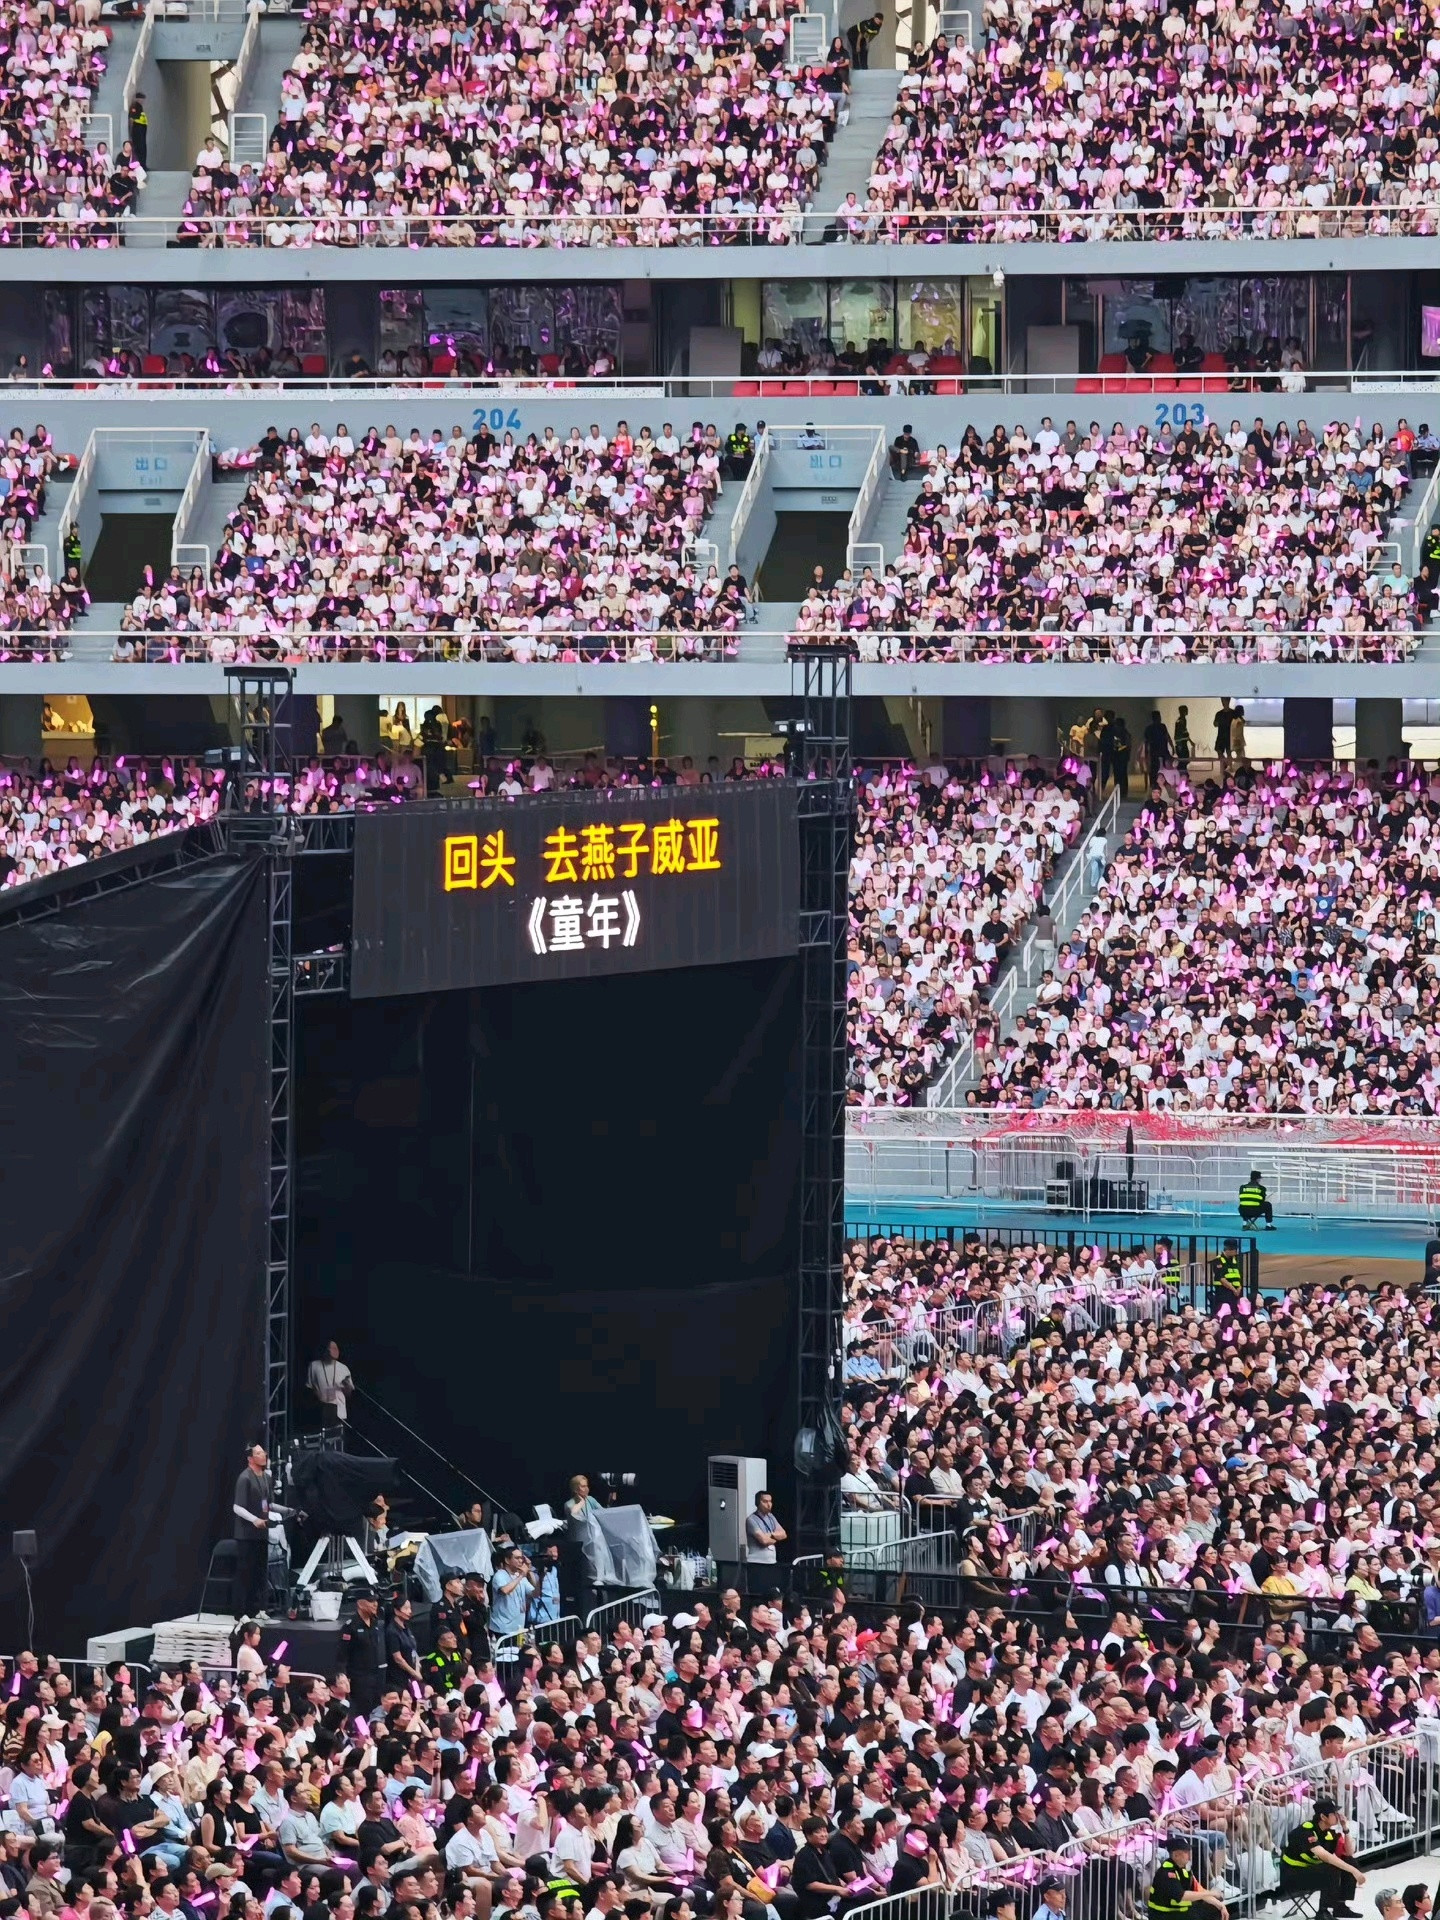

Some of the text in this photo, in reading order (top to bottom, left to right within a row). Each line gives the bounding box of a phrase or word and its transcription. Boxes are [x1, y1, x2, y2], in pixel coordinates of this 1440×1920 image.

[473, 408, 521, 430] 204
[1155, 403, 1205, 426] 203
[444, 818, 721, 891] 回头 去燕子威亚
[528, 889, 640, 954] 《童年》
